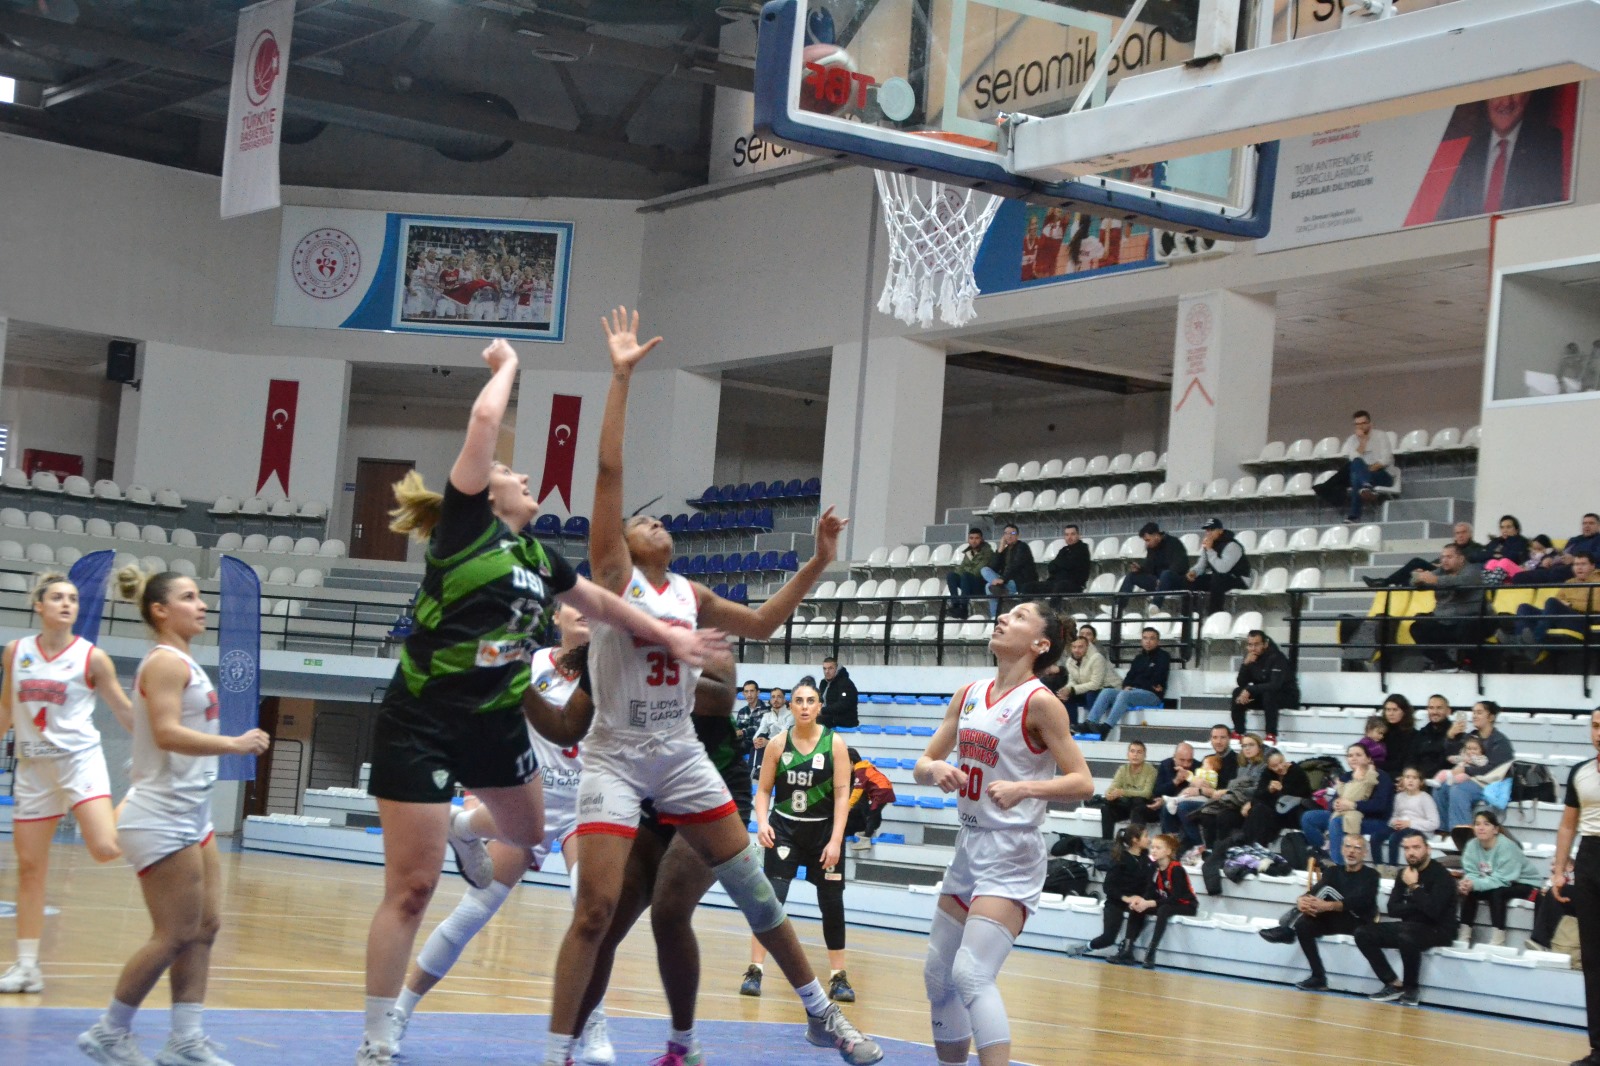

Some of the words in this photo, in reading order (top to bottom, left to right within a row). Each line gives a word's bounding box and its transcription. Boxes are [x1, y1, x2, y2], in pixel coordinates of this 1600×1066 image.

[241, 107, 277, 130] TÜRKİYE
[646, 650, 680, 687] 35
[33, 706, 48, 733] 4
[515, 747, 535, 778] 17
[558, 768, 581, 778] LIDY
[557, 778, 580, 787] GAR
[791, 789, 808, 813] 8
